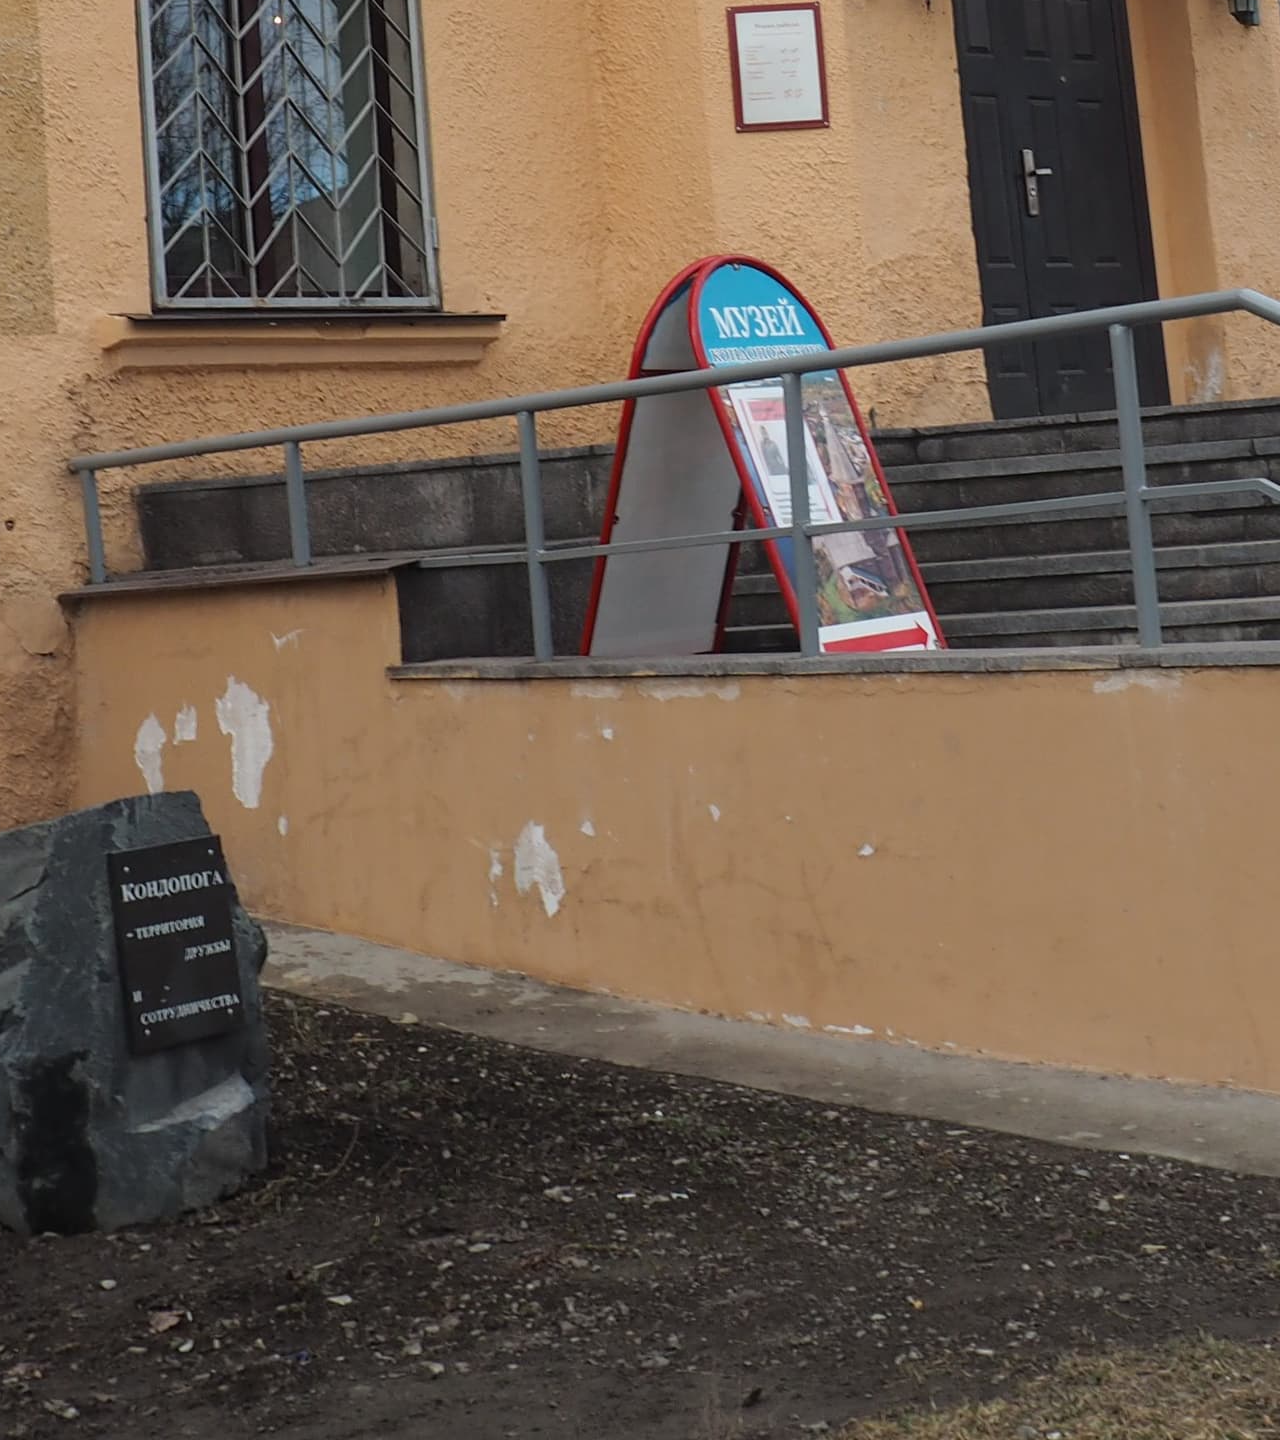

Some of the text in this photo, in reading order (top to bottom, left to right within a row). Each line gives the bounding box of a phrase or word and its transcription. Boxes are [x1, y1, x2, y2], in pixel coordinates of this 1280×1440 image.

[708, 297, 805, 339] МУЗЕЙ
[184, 939, 232, 961] ДРУЖБЫ
[132, 990, 142, 1003] И
[140, 993, 240, 1025] СОТРУДНИЧЕСТВА
